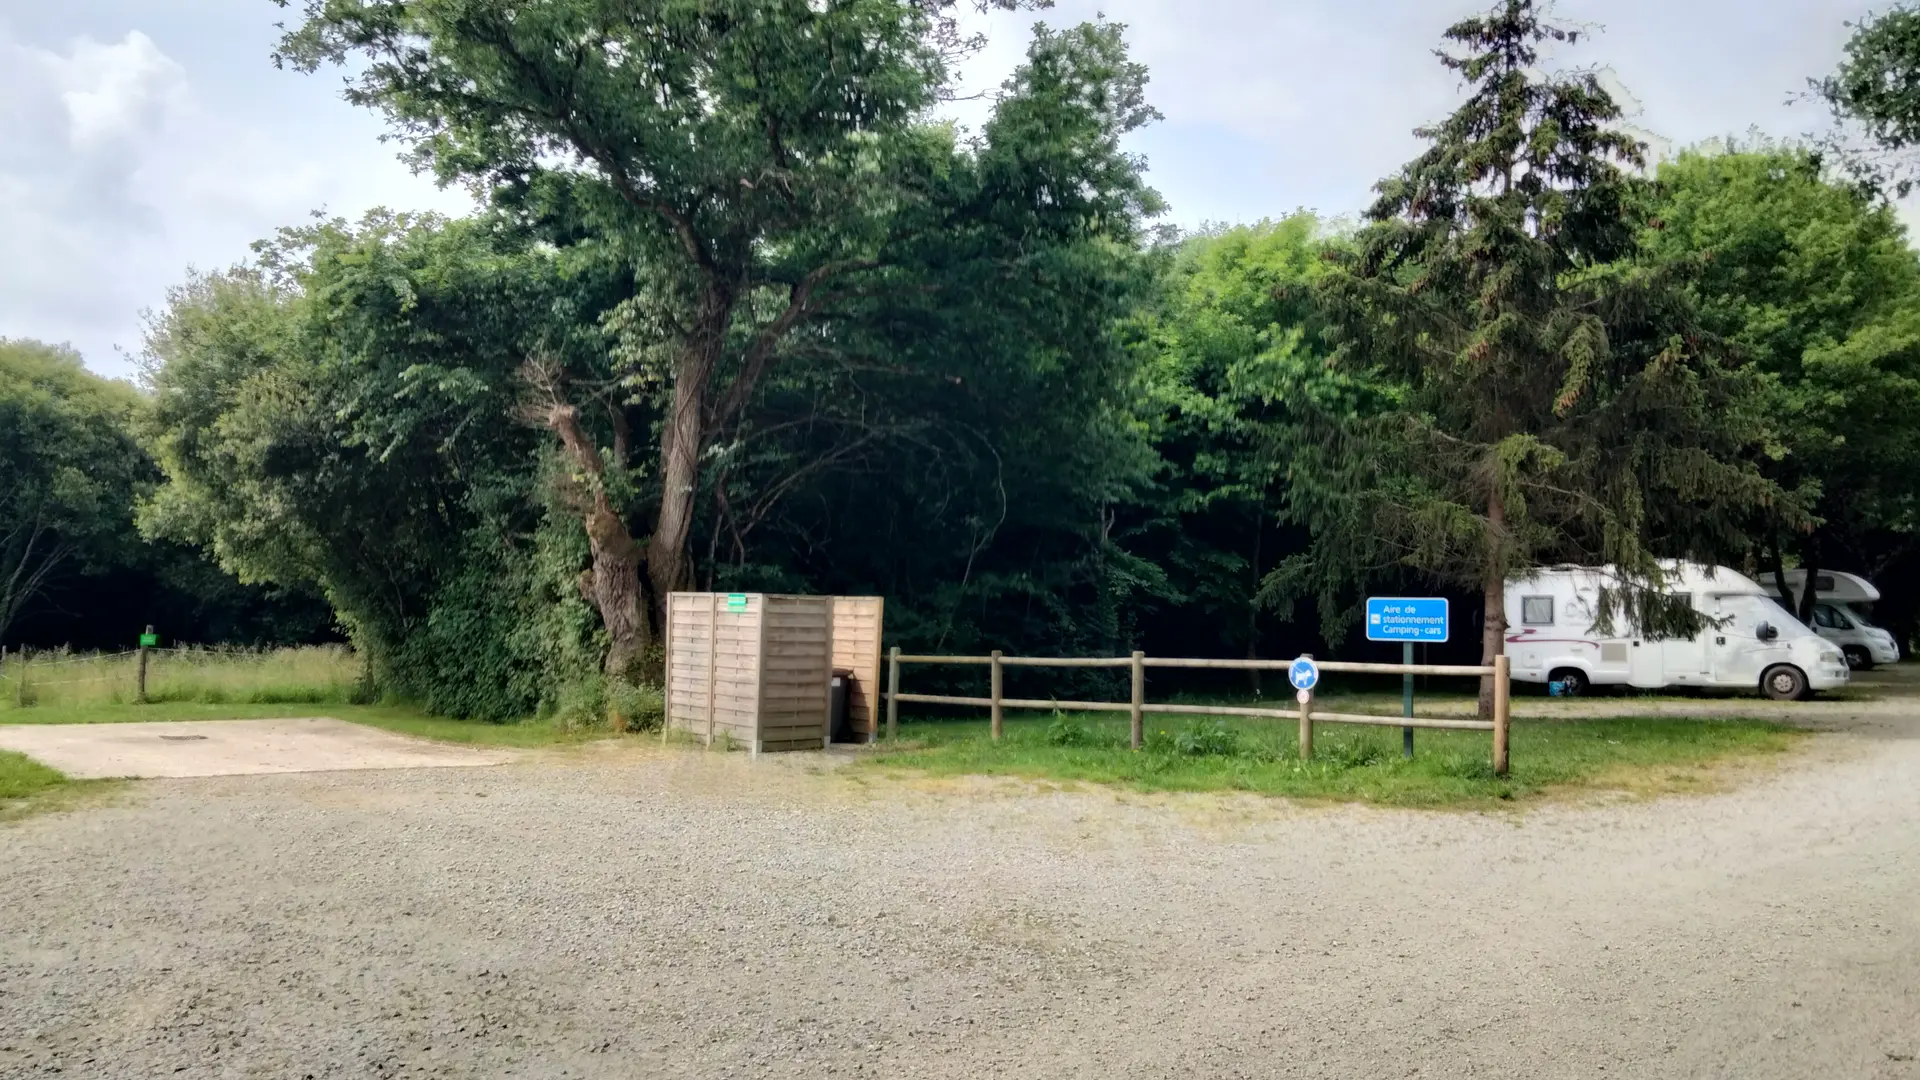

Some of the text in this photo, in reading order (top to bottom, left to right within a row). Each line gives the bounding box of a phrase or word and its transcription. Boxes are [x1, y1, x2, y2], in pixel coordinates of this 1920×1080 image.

[1383, 605, 1416, 614] Aire de
[1382, 615, 1444, 624] stationnement
